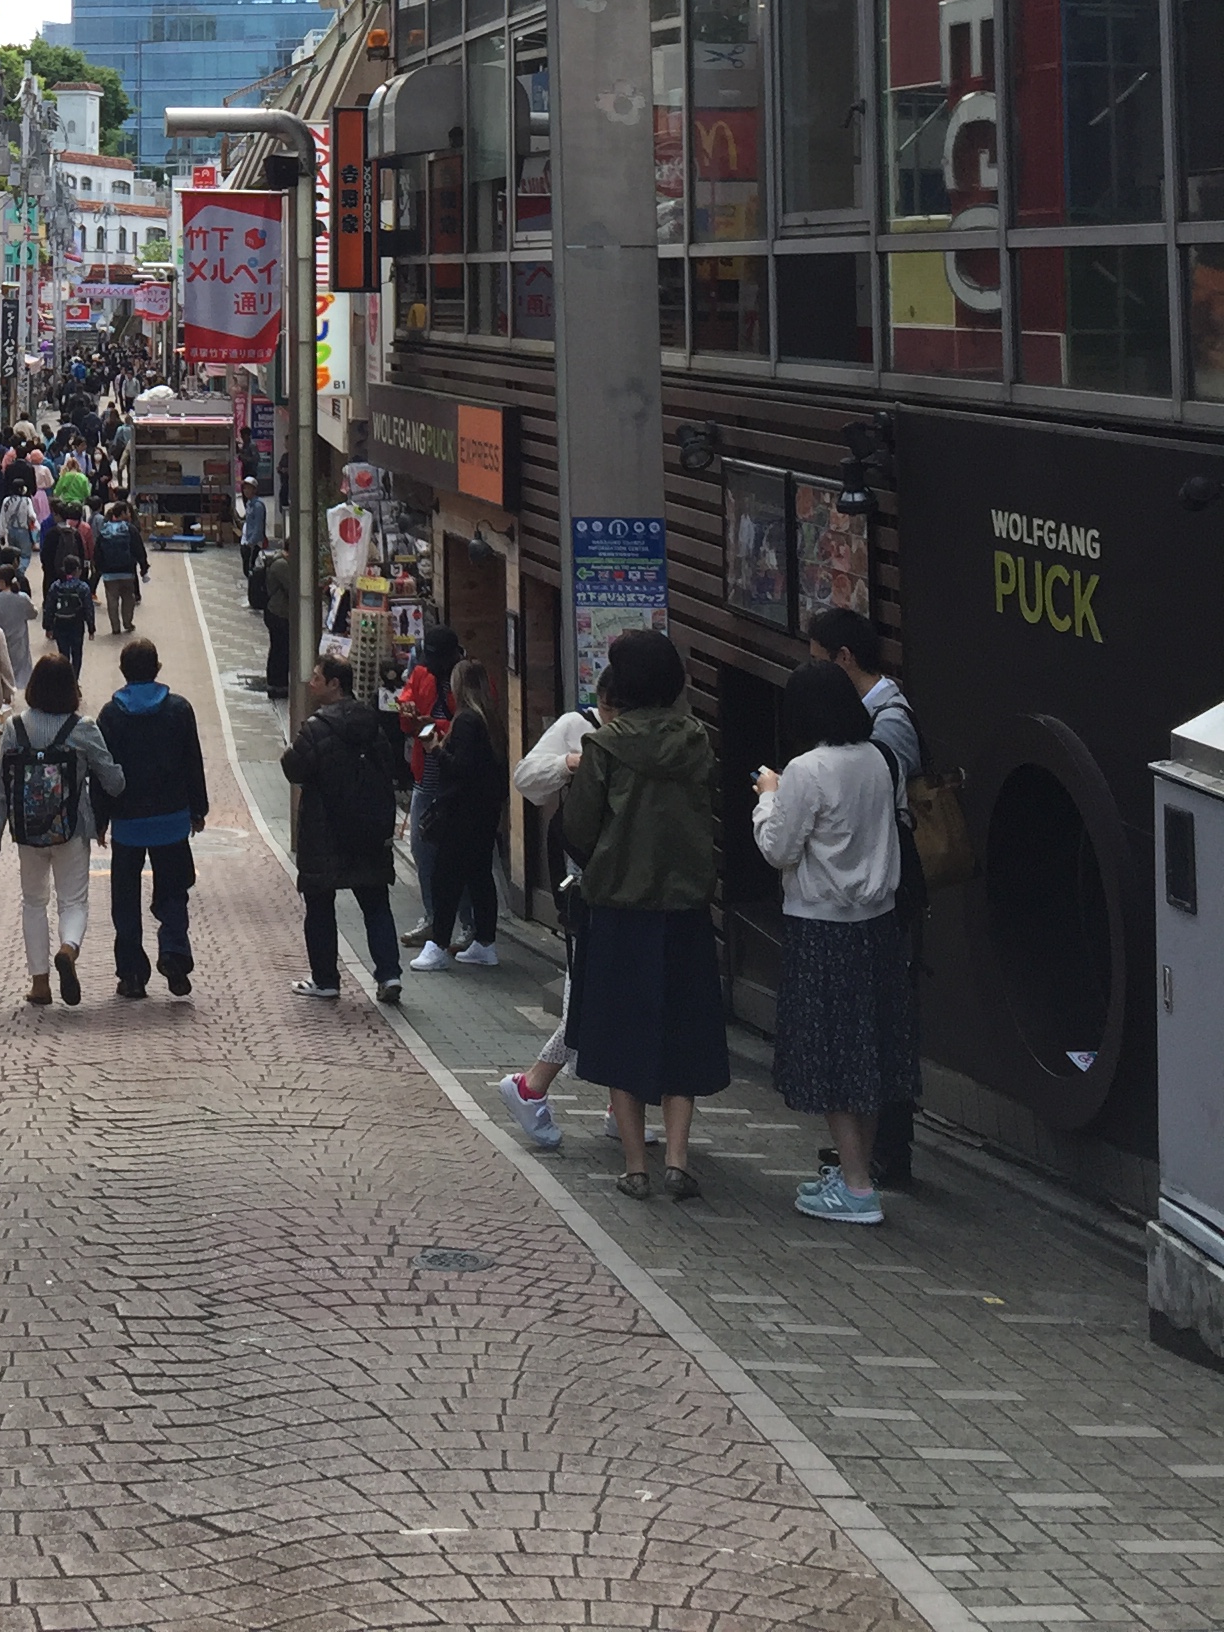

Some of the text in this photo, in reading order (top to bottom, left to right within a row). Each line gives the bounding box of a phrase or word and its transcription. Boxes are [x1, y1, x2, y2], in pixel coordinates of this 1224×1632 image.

[340, 164, 359, 235] 吉野家
[363, 166, 372, 234] YOSHINOYA
[185, 226, 234, 252] 竹下
[185, 256, 278, 285] メルペイ
[233, 292, 272, 316] 通り
[333, 379, 346, 390] B1
[371, 412, 501, 473] WOLFGANG PUCK EXPRESS
[991, 509, 1102, 561] WOLFGANG
[992, 550, 1104, 644] PUCK
